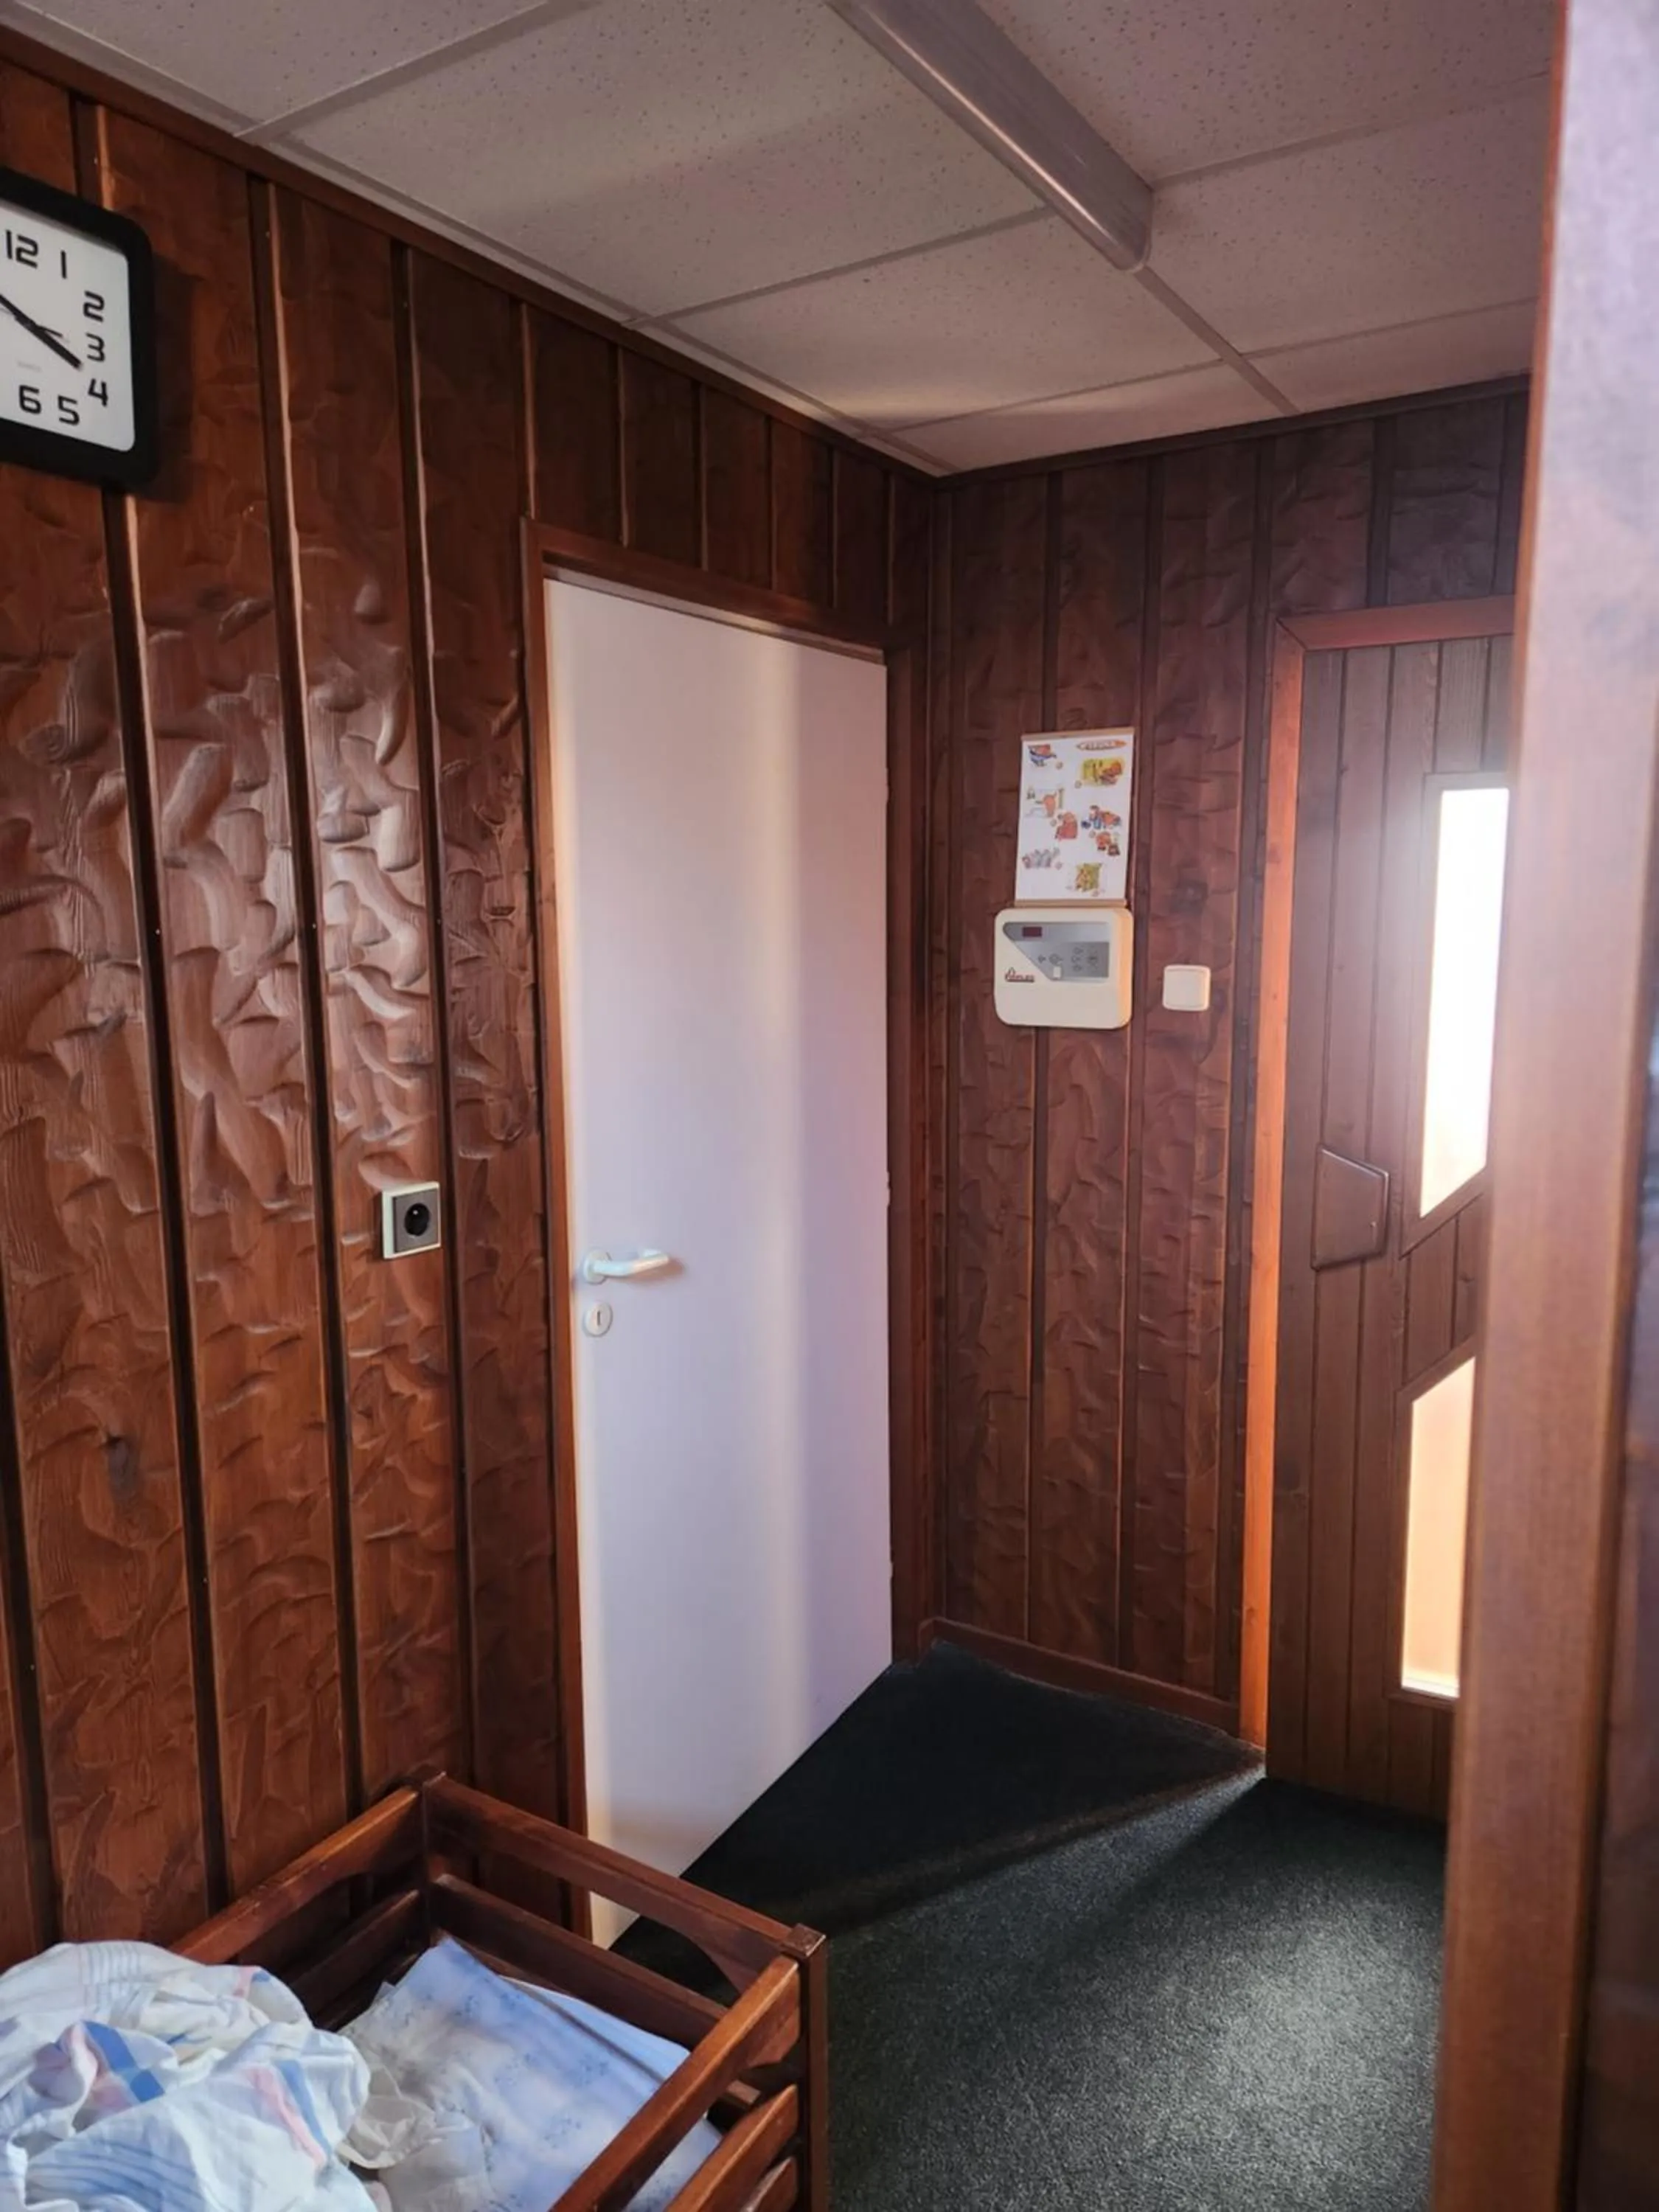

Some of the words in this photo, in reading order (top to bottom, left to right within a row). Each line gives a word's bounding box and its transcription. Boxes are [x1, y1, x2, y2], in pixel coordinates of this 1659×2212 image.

[5, 229, 39, 268] 12
[60, 249, 68, 279] 1
[83, 291, 105, 322] 2
[86, 333, 105, 362] 3
[18, 384, 42, 414] 6
[88, 378, 108, 407] 4
[57, 395, 80, 426] 5
